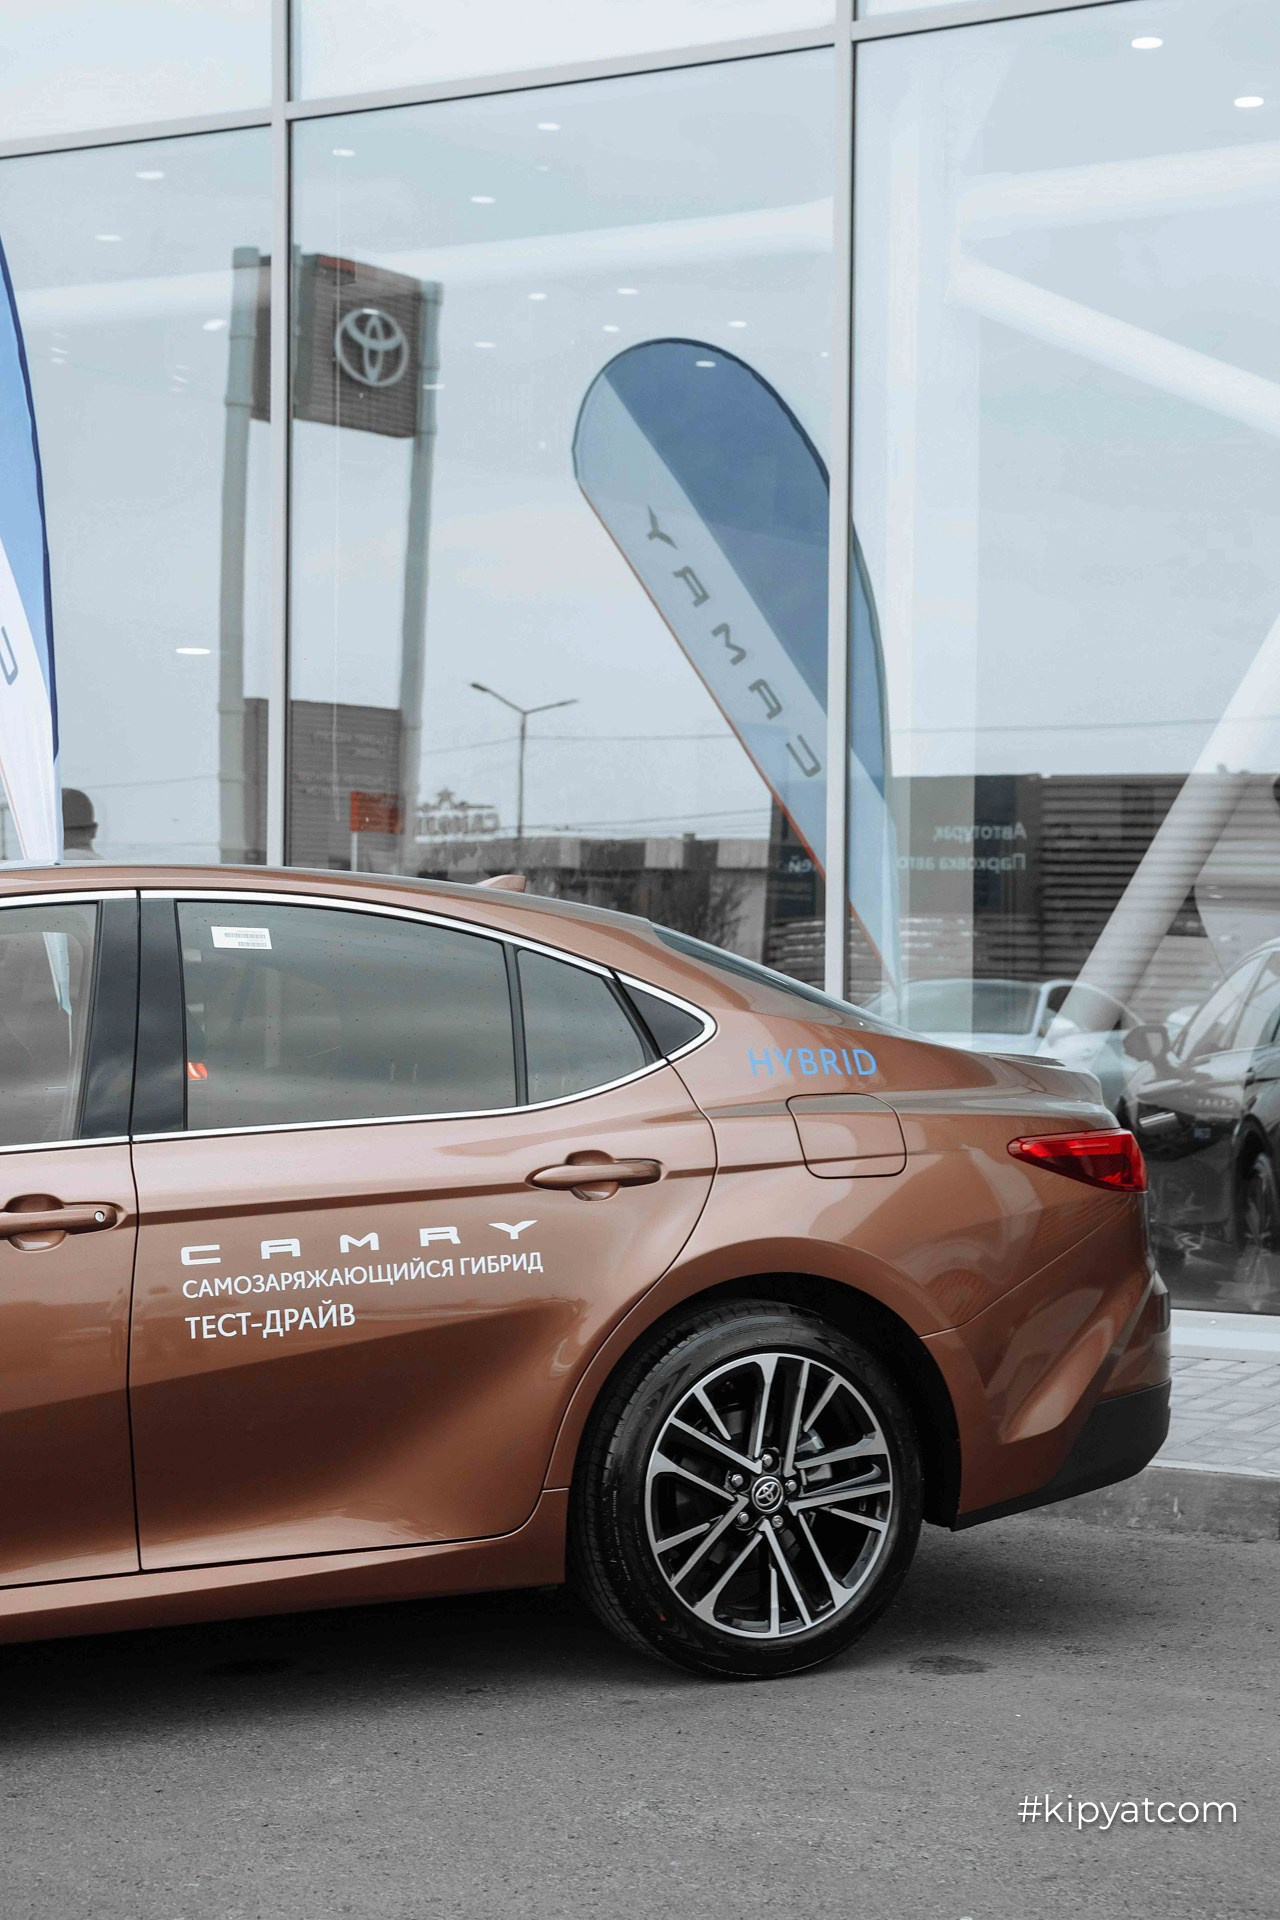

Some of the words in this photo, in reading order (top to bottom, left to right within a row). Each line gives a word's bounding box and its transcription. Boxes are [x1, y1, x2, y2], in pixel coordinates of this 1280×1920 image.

[746, 1047, 878, 1077] HYBRID
[181, 1219, 538, 1266] CAMRY
[182, 1257, 454, 1299] САМОЗАРЯЖАЮЩИЙСЯ
[460, 1251, 544, 1277] ГИБРИД
[184, 1299, 356, 1339] ТЕСТ-ДРАЙВ
